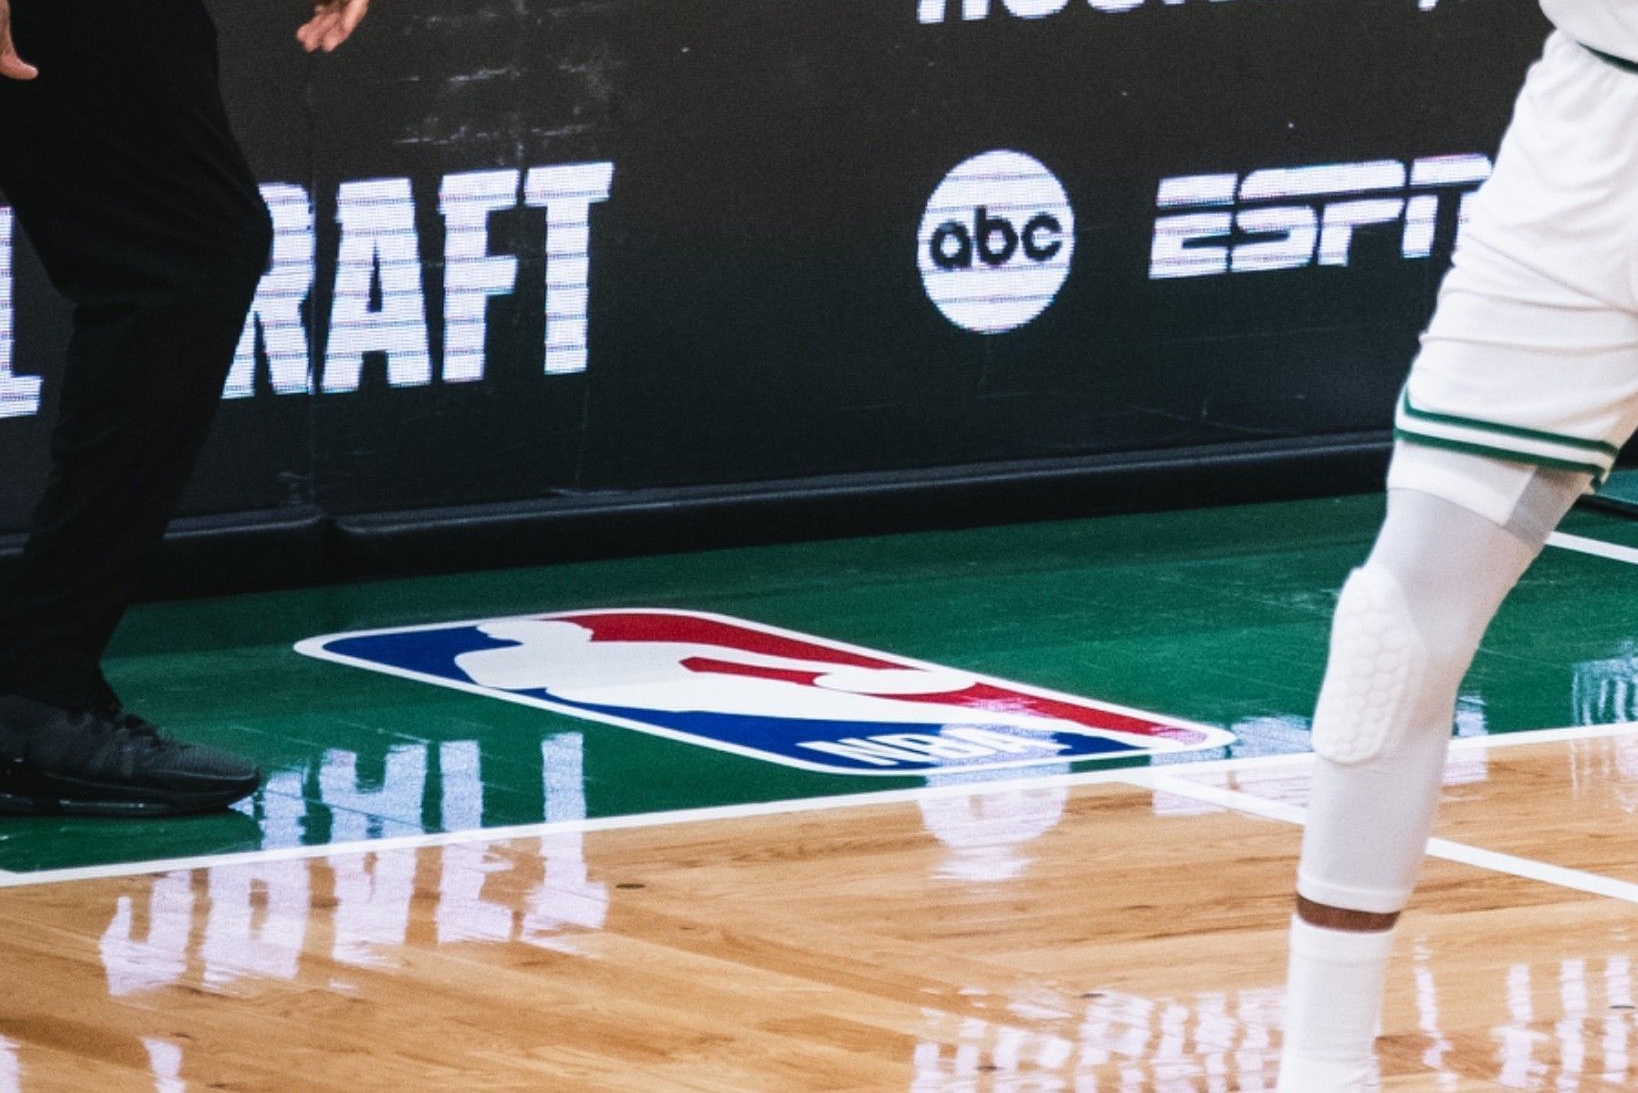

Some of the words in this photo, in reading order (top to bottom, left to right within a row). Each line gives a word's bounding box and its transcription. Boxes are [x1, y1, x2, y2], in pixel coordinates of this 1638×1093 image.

[928, 203, 1064, 272] abc
[220, 161, 615, 400] RAFT
[795, 727, 1073, 766] NBA
